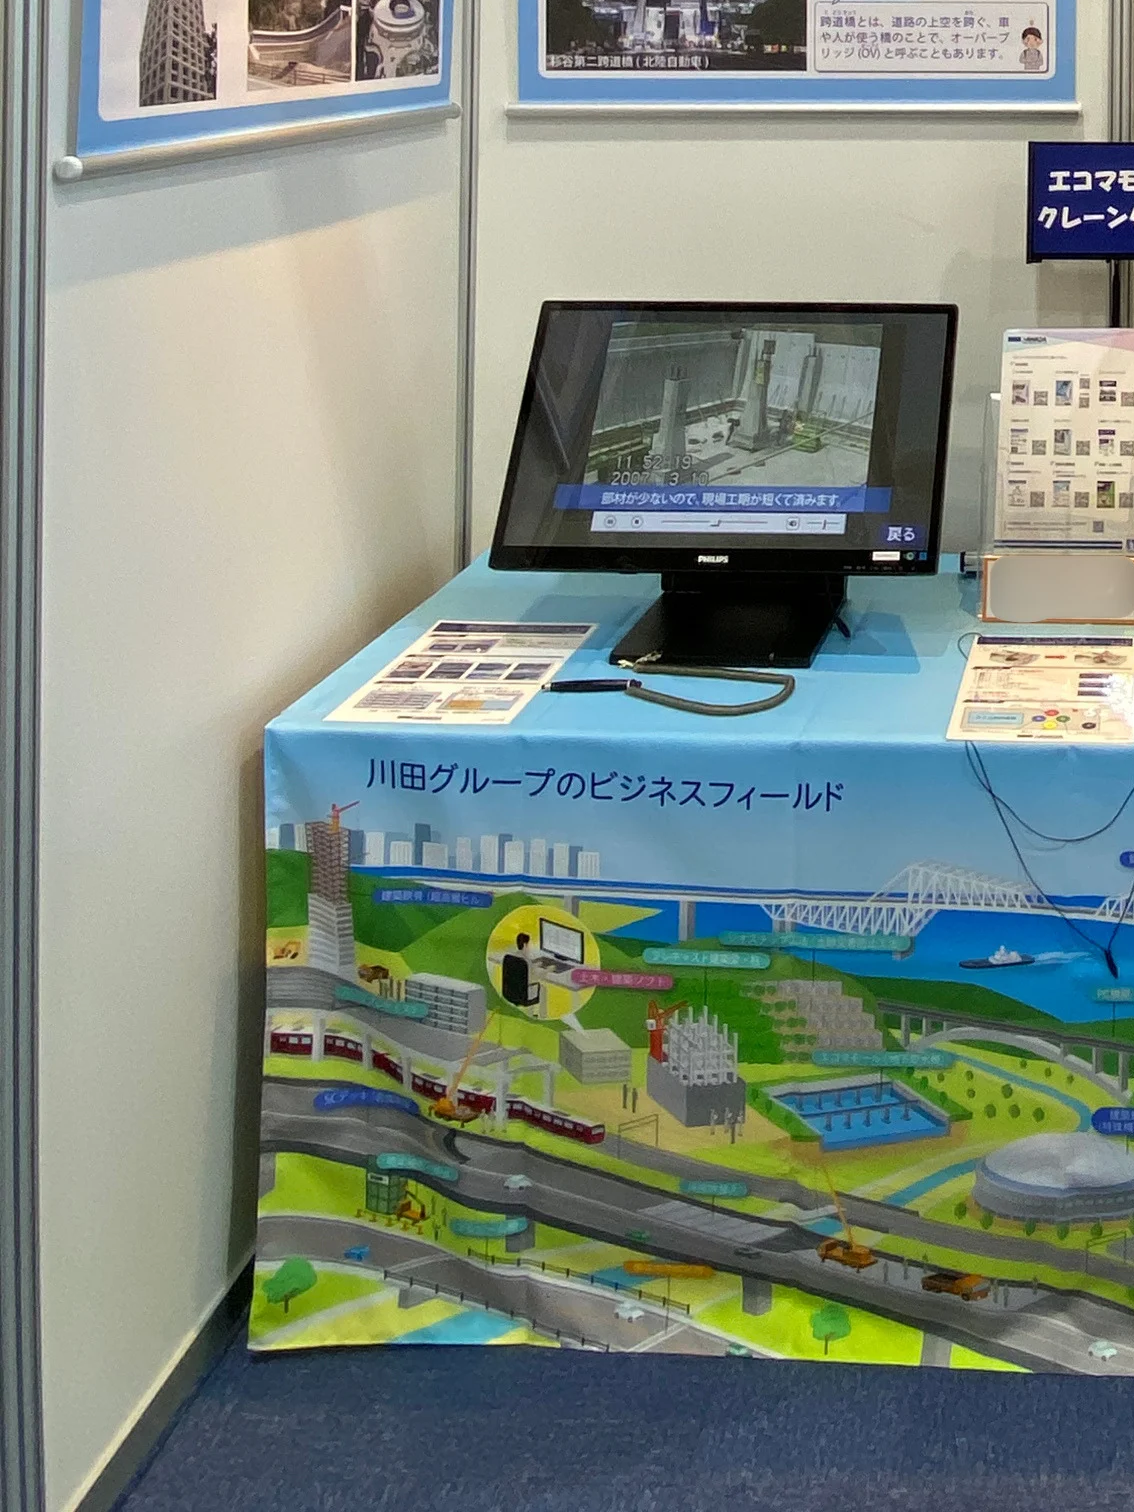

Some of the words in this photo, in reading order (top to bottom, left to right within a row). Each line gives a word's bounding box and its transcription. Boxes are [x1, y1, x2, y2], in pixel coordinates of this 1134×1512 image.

[821, 31, 1010, 44] や人が使う橋のことで、オーバーブ
[887, 527, 915, 541] 戻る
[698, 555, 728, 564] PHILIPS
[366, 759, 845, 812] 川田グループのビジネスフィールド
